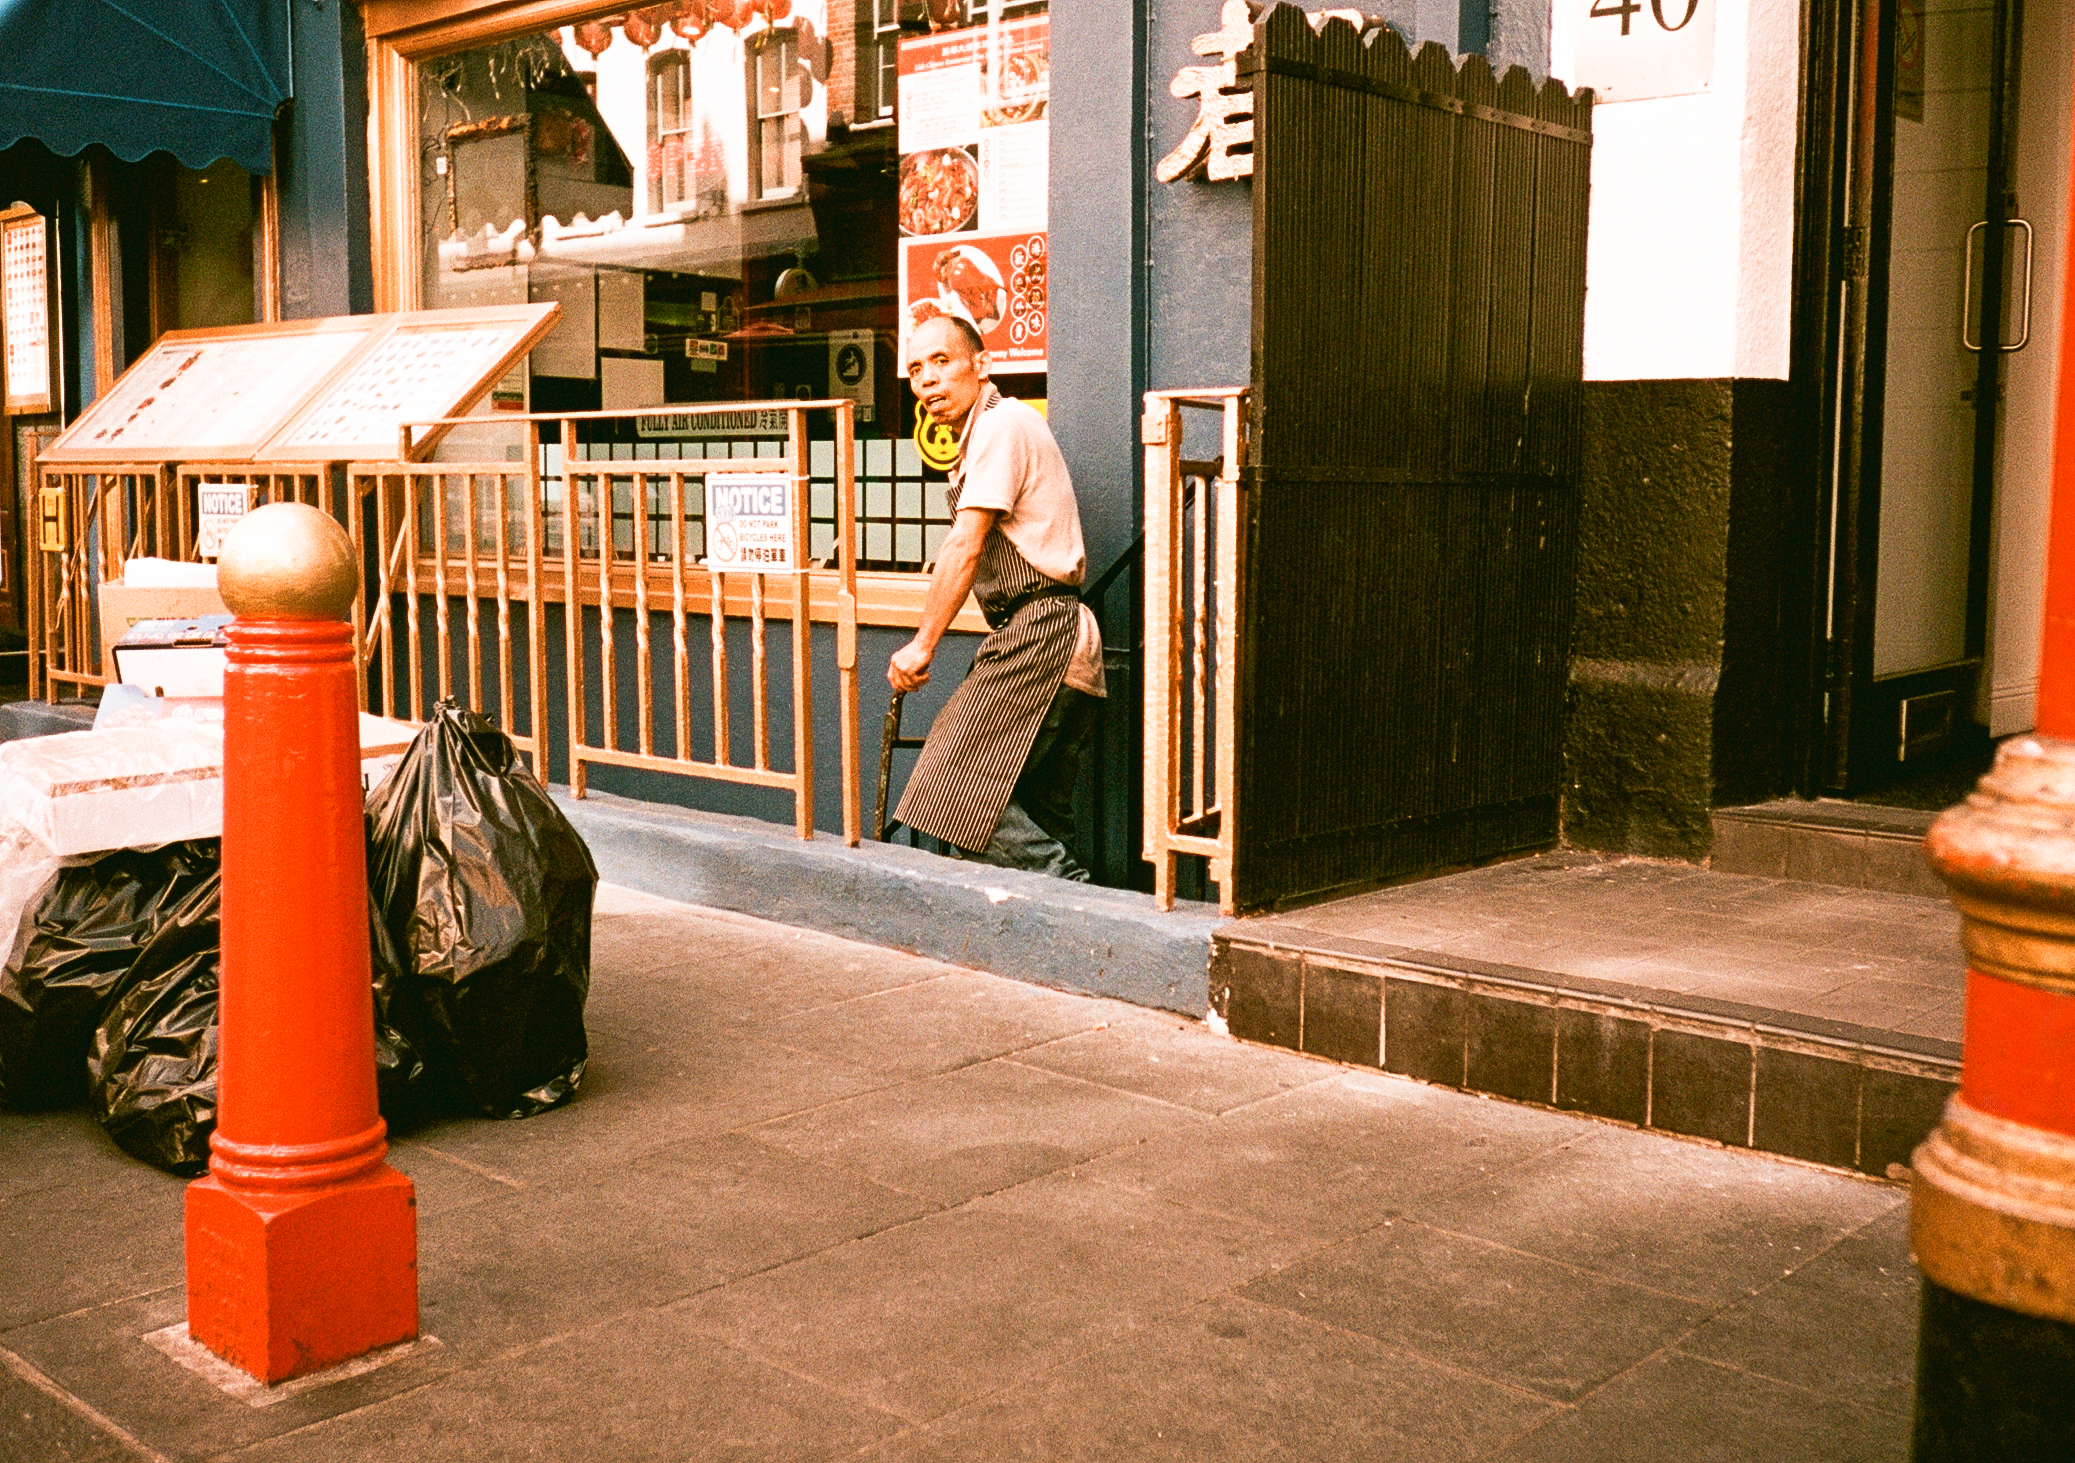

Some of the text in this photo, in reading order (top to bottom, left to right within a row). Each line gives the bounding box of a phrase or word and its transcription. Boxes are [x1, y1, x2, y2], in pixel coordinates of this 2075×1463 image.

[1009, 347, 1044, 358] Welcome
[641, 414, 670, 431] FULLY
[672, 413, 688, 431] AIR
[691, 410, 757, 431] CONDITIONED
[203, 493, 242, 514] NOTICE
[714, 486, 783, 514] NOTICE
[739, 520, 779, 529] DO NOT PARK
[739, 533, 786, 543] BICYCLES HERE
